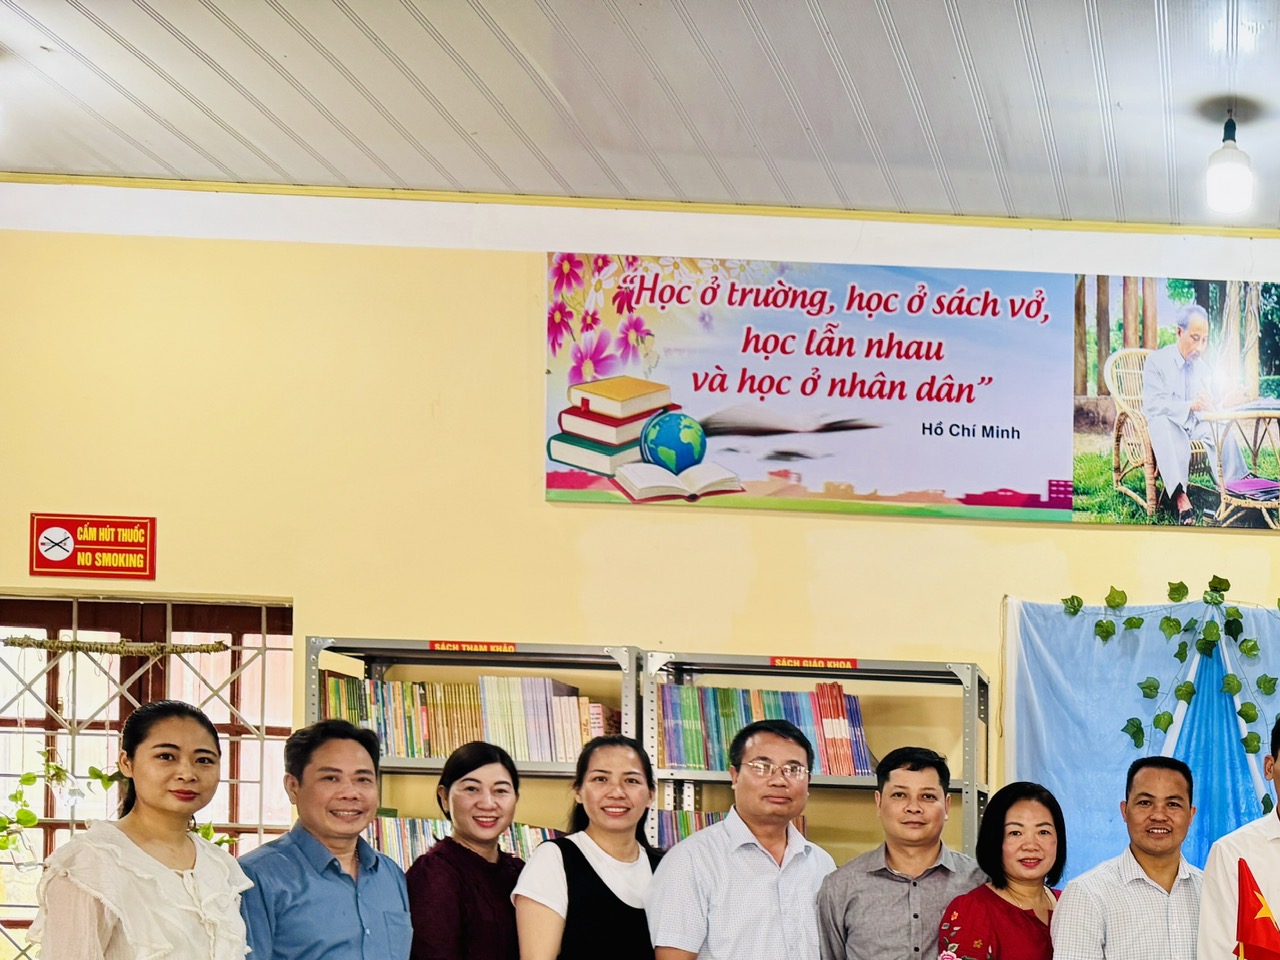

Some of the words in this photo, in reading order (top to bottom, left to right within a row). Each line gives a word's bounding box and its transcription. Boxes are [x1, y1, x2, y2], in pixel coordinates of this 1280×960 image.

[700, 280, 721, 307] ở
[727, 282, 834, 317] trường,
[845, 285, 898, 316] học
[906, 284, 927, 314] ở
[932, 285, 1000, 318] sách
[1009, 288, 1051, 324] vở,
[741, 326, 795, 360] học
[805, 322, 855, 358] lẫn
[866, 329, 944, 361] nhau
[692, 366, 728, 393] và
[736, 368, 791, 401] học
[800, 366, 820, 397] ở
[829, 371, 907, 401] nhân
[915, 374, 993, 405] dân”
[921, 421, 944, 437] Hồ
[949, 421, 976, 438] Chí
[982, 425, 1021, 440] Minh
[77, 522, 97, 541] CẤM
[99, 525, 115, 542] HÚT
[117, 524, 145, 543] THUỐC
[77, 552, 92, 566] NO
[95, 552, 144, 568] SMOKING
[434, 642, 459, 651] SÁCH
[461, 643, 488, 652] THAM
[775, 658, 800, 667] SÁCH
[802, 659, 825, 668] GIÁO
[827, 661, 853, 669] KHOA
